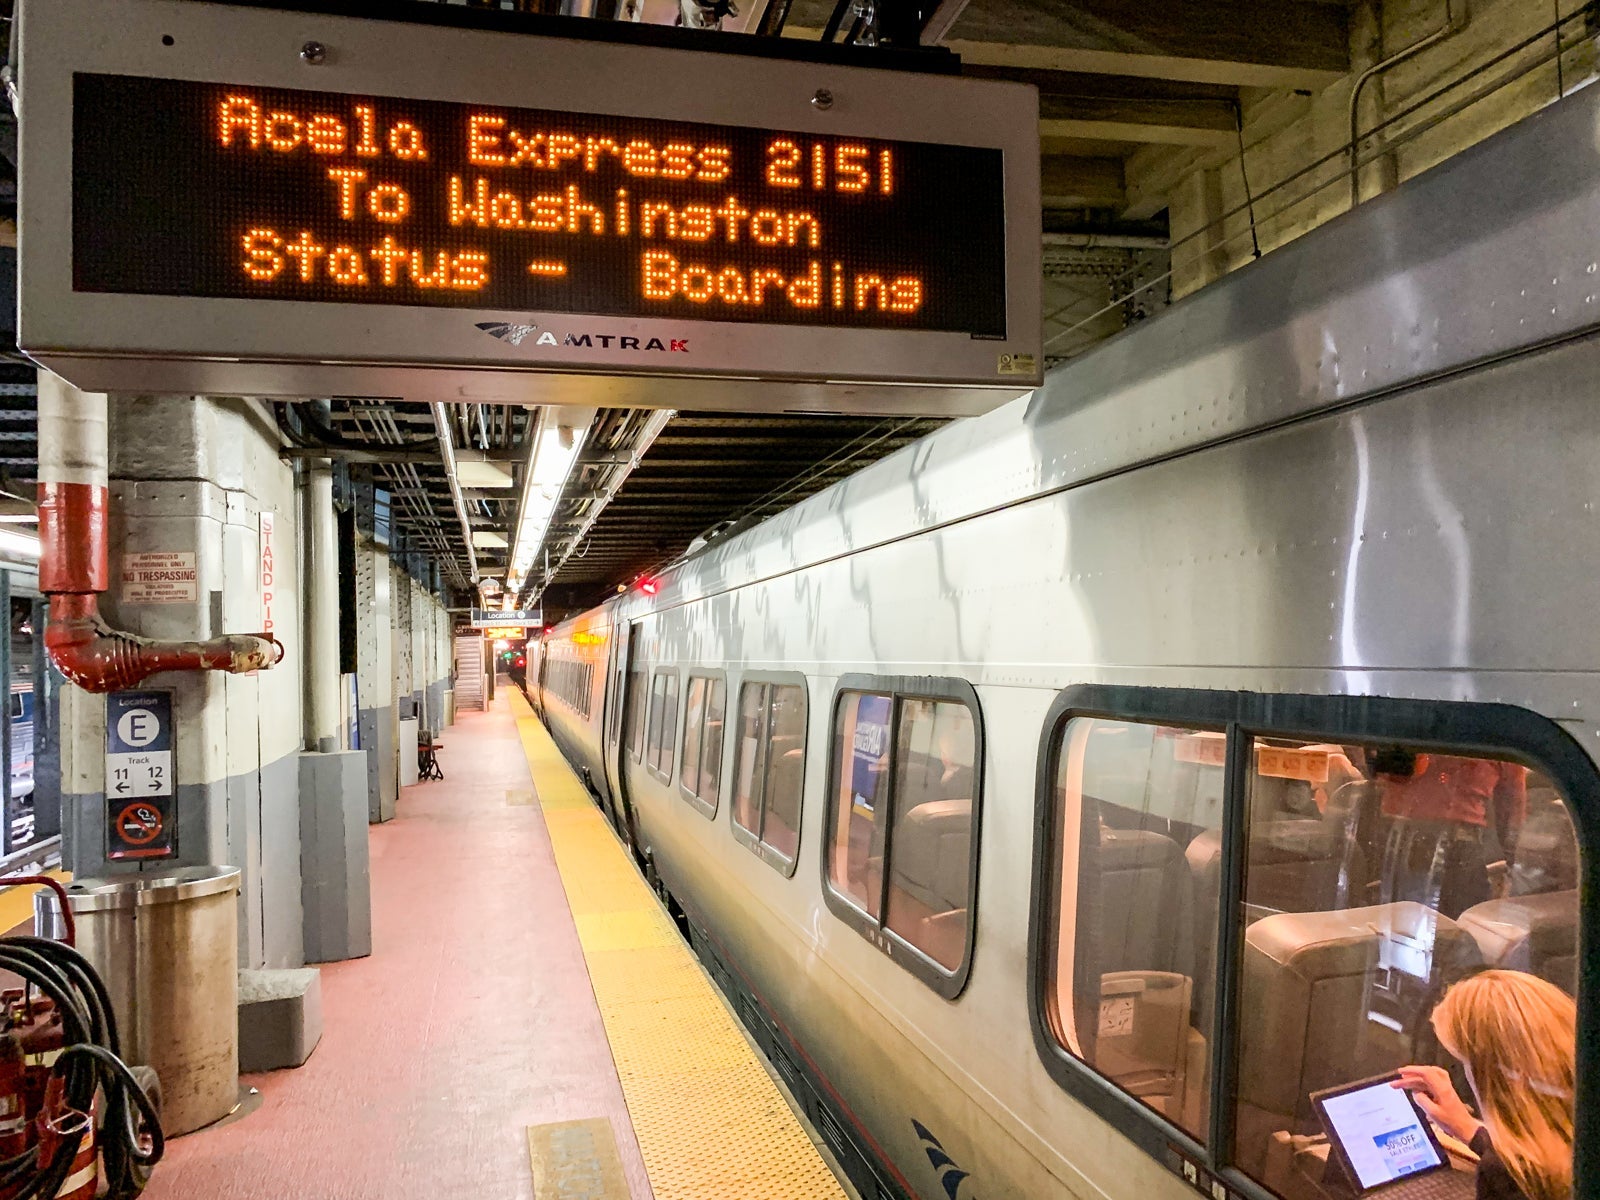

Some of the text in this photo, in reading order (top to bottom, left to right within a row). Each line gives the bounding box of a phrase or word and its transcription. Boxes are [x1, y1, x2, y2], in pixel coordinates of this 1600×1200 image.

[217, 93, 894, 195] Acela Express 2151
[328, 164, 821, 248] To Washington
[240, 227, 490, 291] Status
[640, 249, 923, 313] Boarding
[536, 331, 690, 353] AMTRAK
[123, 571, 195, 581] NO TRESPASSING
[262, 518, 273, 633] STAND PIP
[119, 698, 158, 706] Location
[130, 714, 147, 740] E
[114, 766, 163, 780] 11 12
[128, 757, 150, 765] Track
